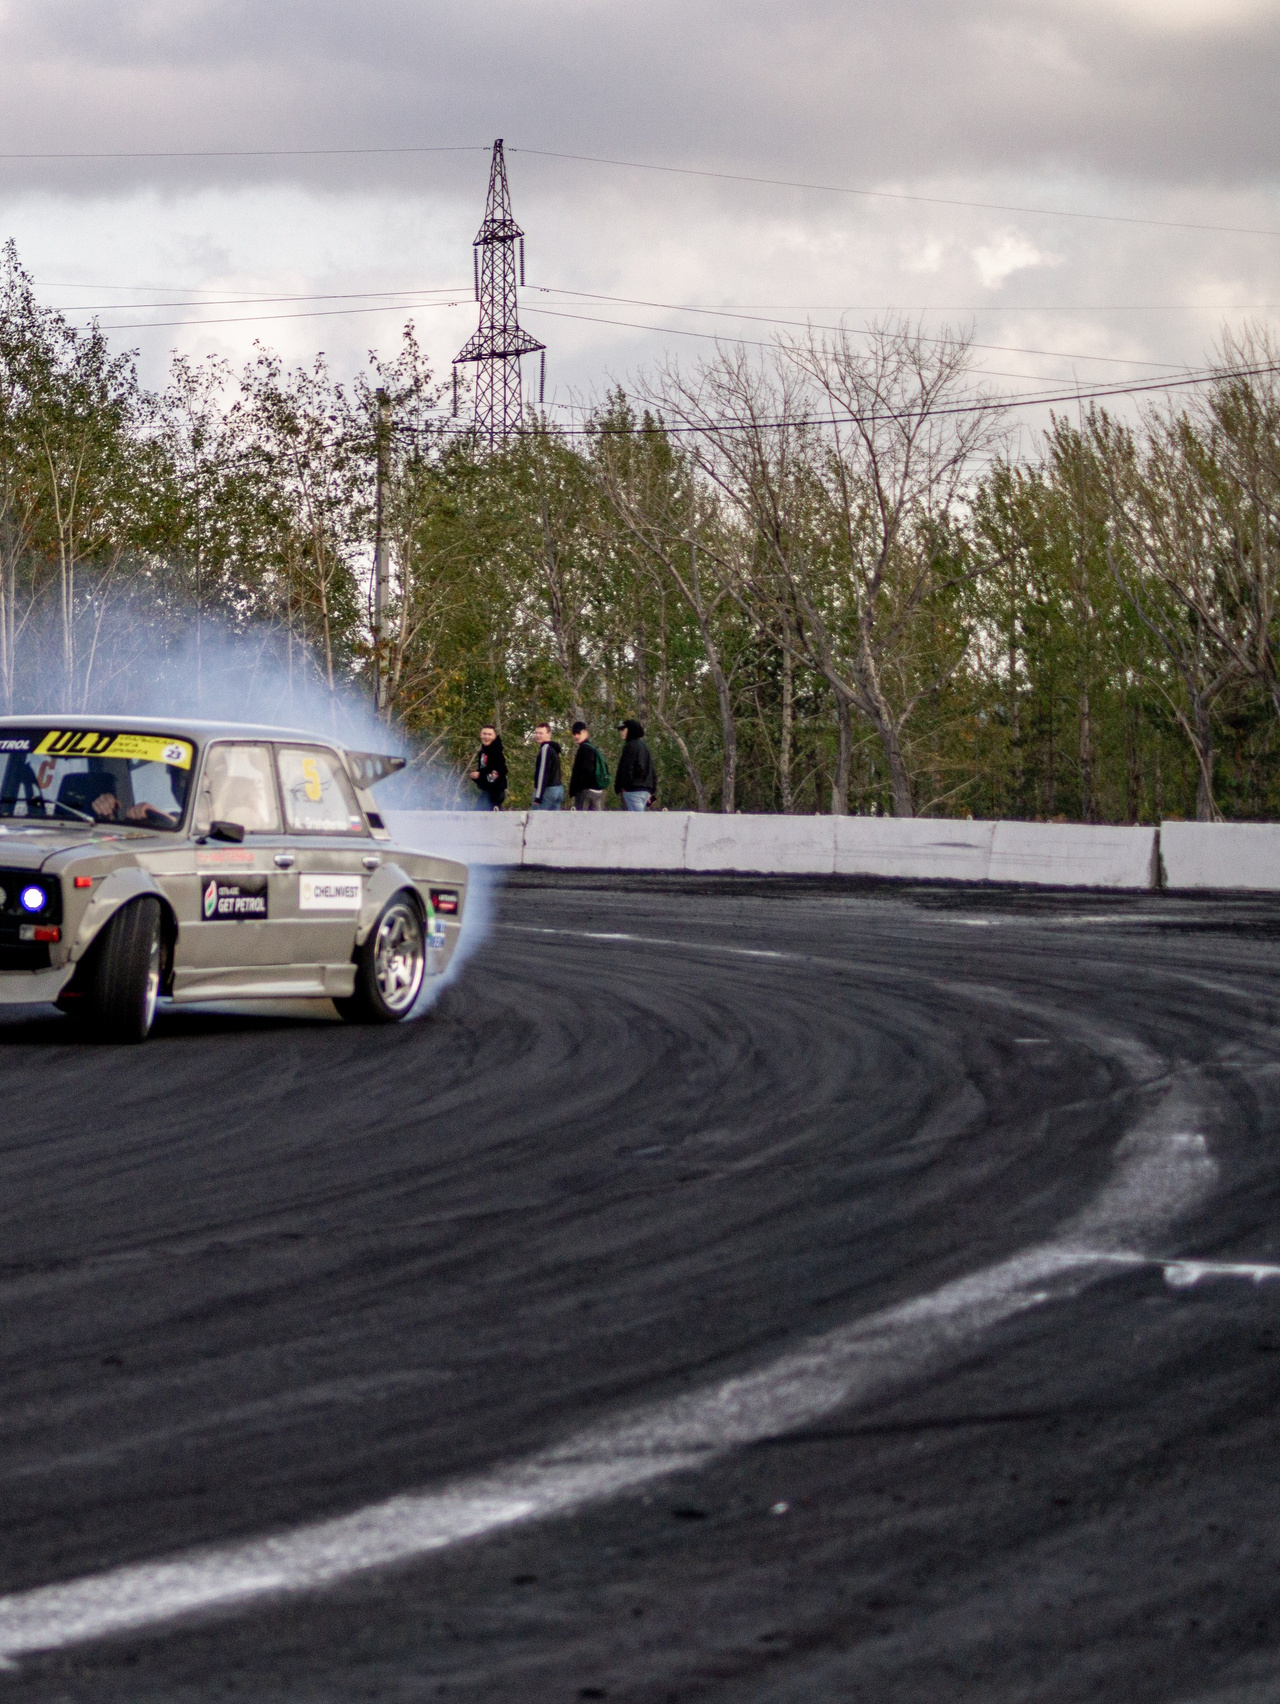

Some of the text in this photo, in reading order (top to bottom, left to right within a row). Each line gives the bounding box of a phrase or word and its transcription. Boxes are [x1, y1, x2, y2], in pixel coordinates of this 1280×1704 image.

[166, 749, 182, 760] 23
[301, 757, 322, 801] 5
[313, 885, 359, 898] CHELINVEST
[218, 896, 266, 913] GET PETROL
